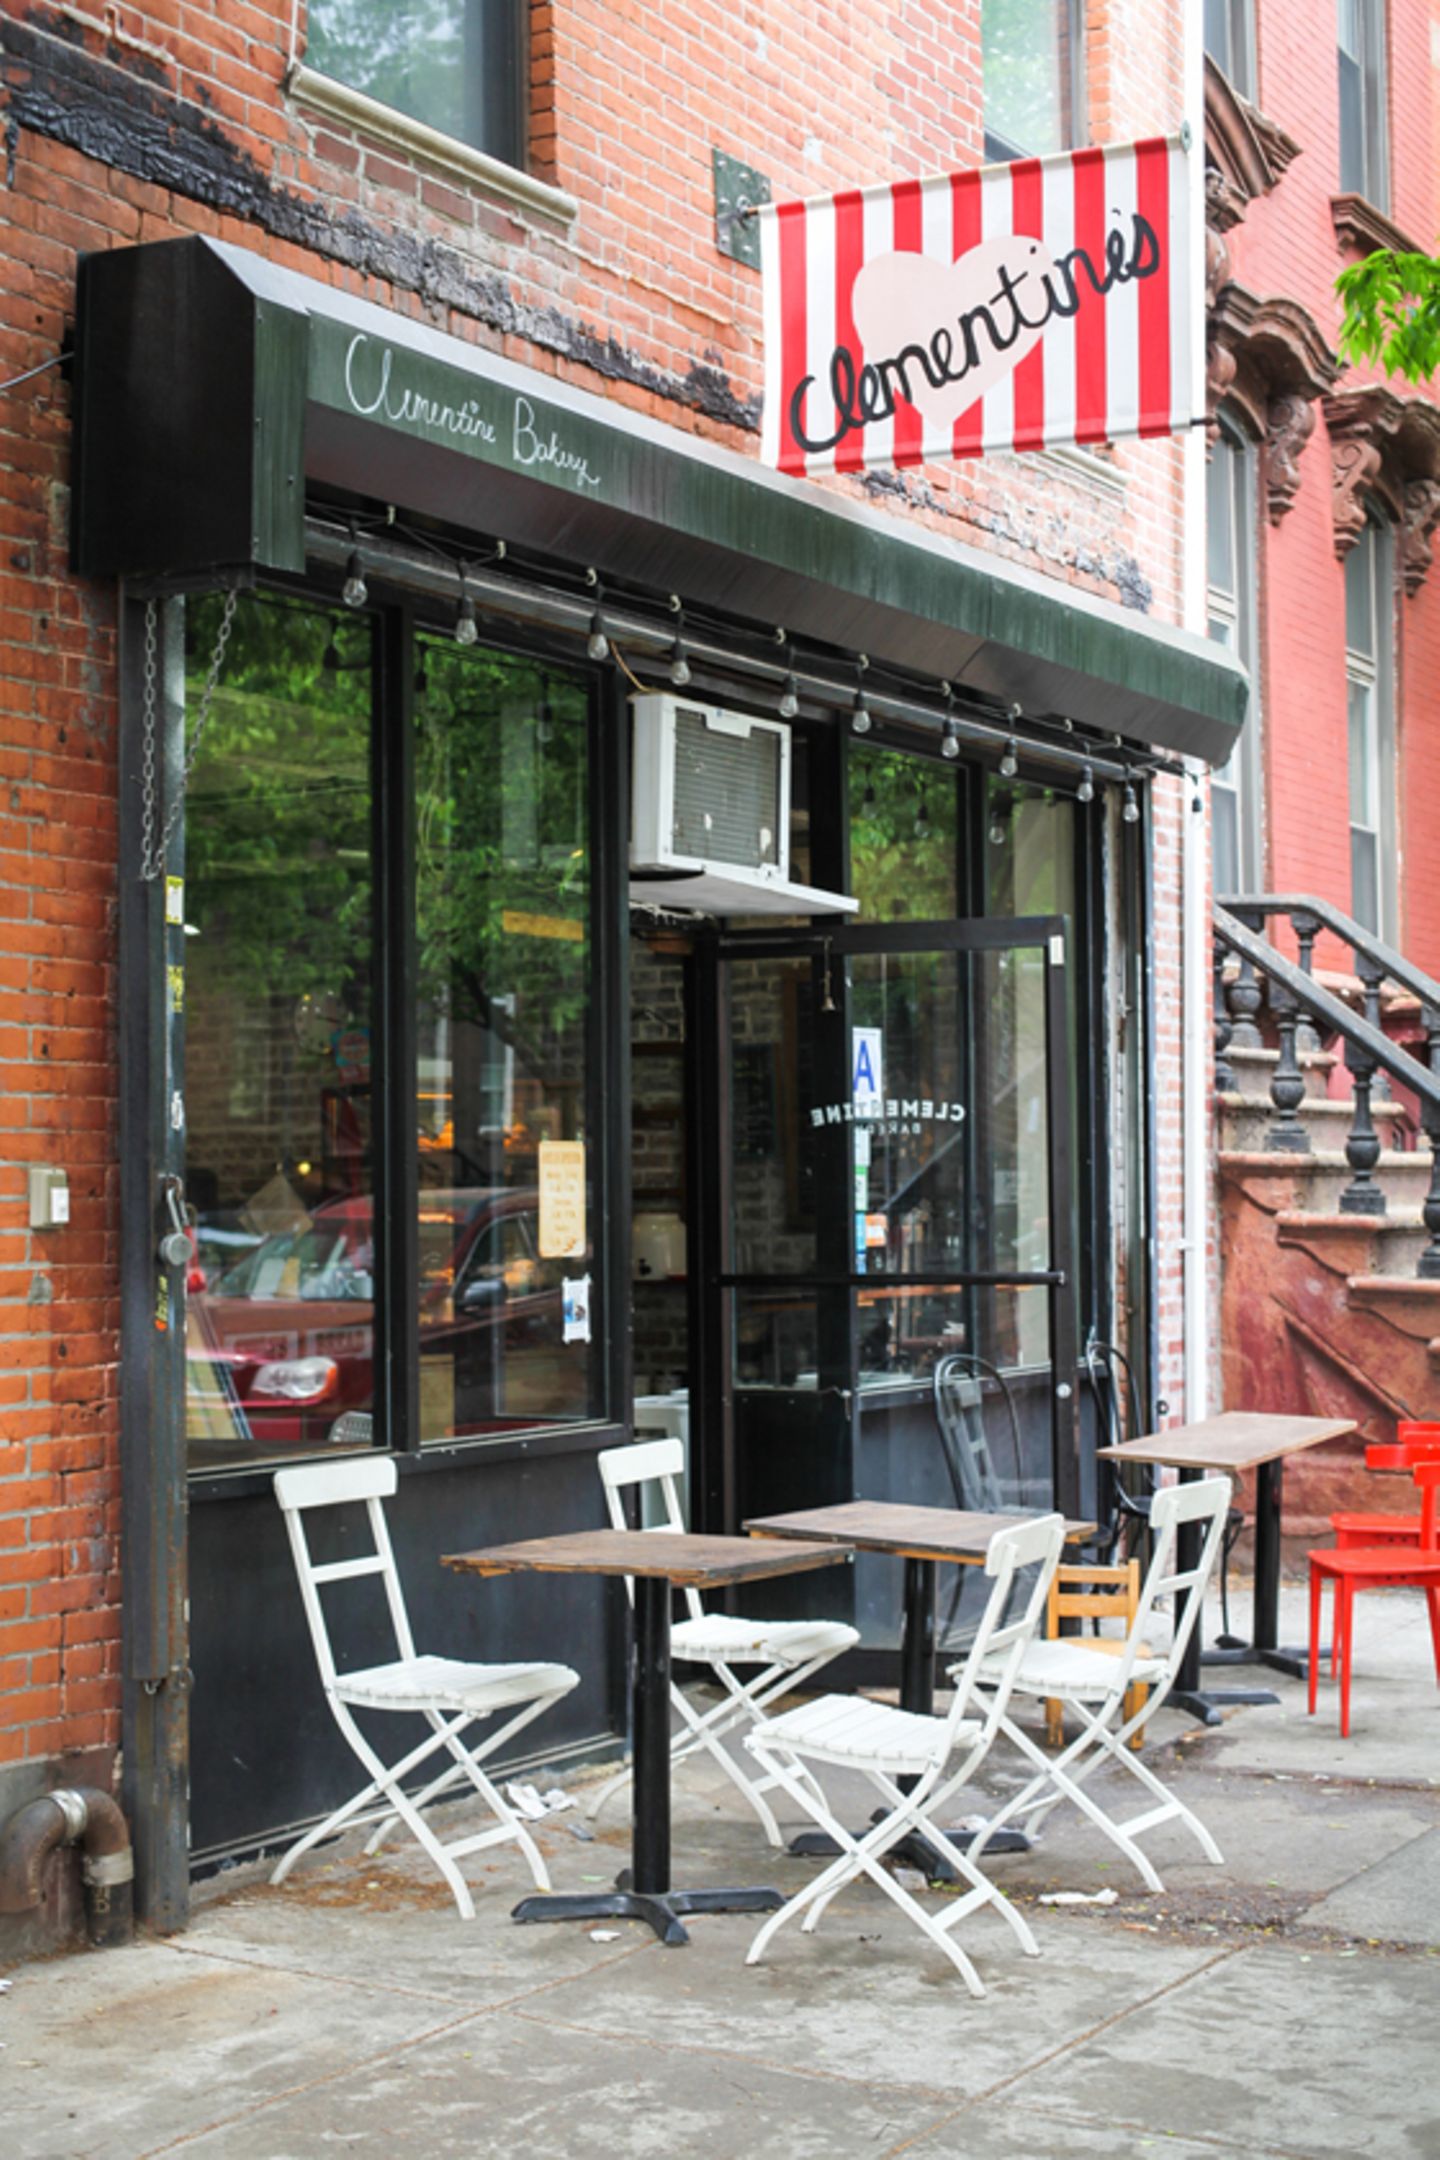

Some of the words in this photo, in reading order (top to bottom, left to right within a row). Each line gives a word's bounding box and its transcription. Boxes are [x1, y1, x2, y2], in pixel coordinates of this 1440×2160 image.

[345, 333, 496, 443] Clementine
[513, 397, 600, 486] Bakery
[853, 1039, 876, 1092] A
